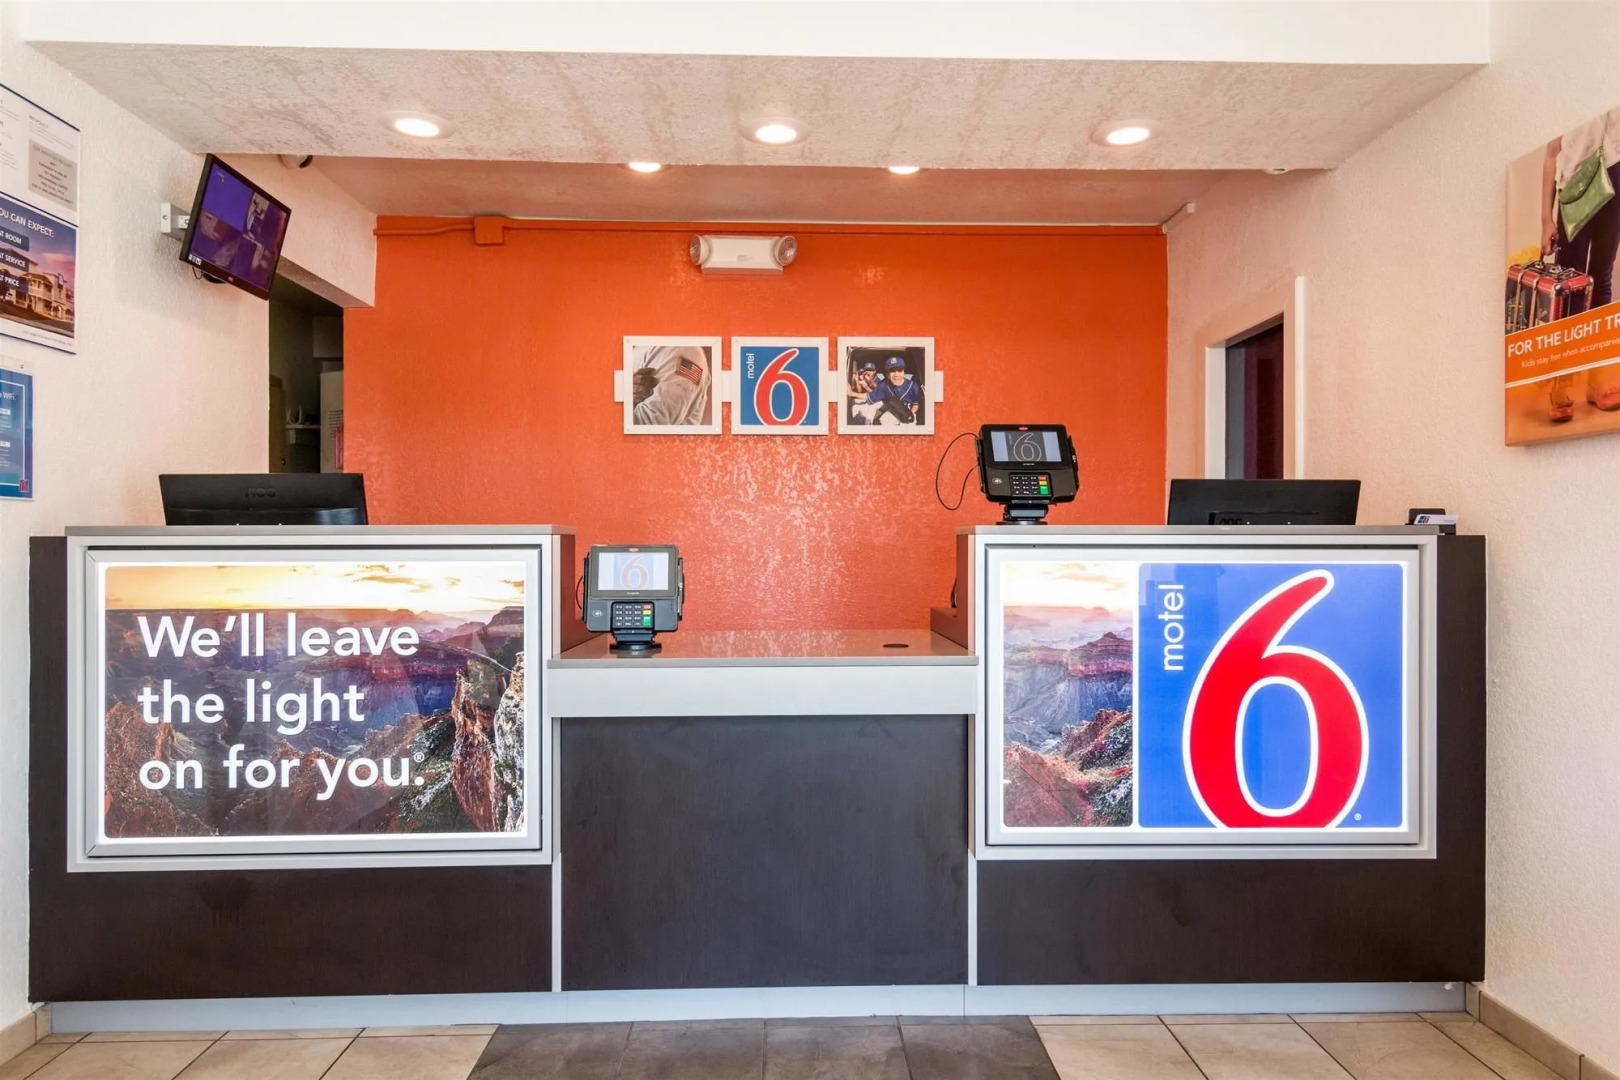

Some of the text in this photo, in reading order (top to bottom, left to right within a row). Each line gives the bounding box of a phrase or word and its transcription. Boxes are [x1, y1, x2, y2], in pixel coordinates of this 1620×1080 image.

[5, 232, 22, 244] ROOM
[10, 213, 26, 226] CAN
[27, 220, 54, 238] EXPECT:
[5, 254, 26, 268] SERVICE
[4, 276, 20, 287] PRICE
[1507, 340, 1533, 358] FOR
[1536, 331, 1562, 350] THE
[1563, 319, 1602, 343] LIGHT
[745, 352, 755, 379] motel
[1521, 360, 1536, 368] Kids
[1536, 357, 1549, 366] stay
[1562, 348, 1579, 357] when
[753, 348, 810, 425] 6
[1013, 432, 1042, 461] 6
[621, 555, 648, 590] 6
[137, 612, 420, 658] We'll leave
[1157, 584, 1184, 671] motel
[137, 678, 365, 736] the light
[1182, 569, 1370, 828] 6
[139, 758, 203, 790] on
[223, 743, 300, 789] for
